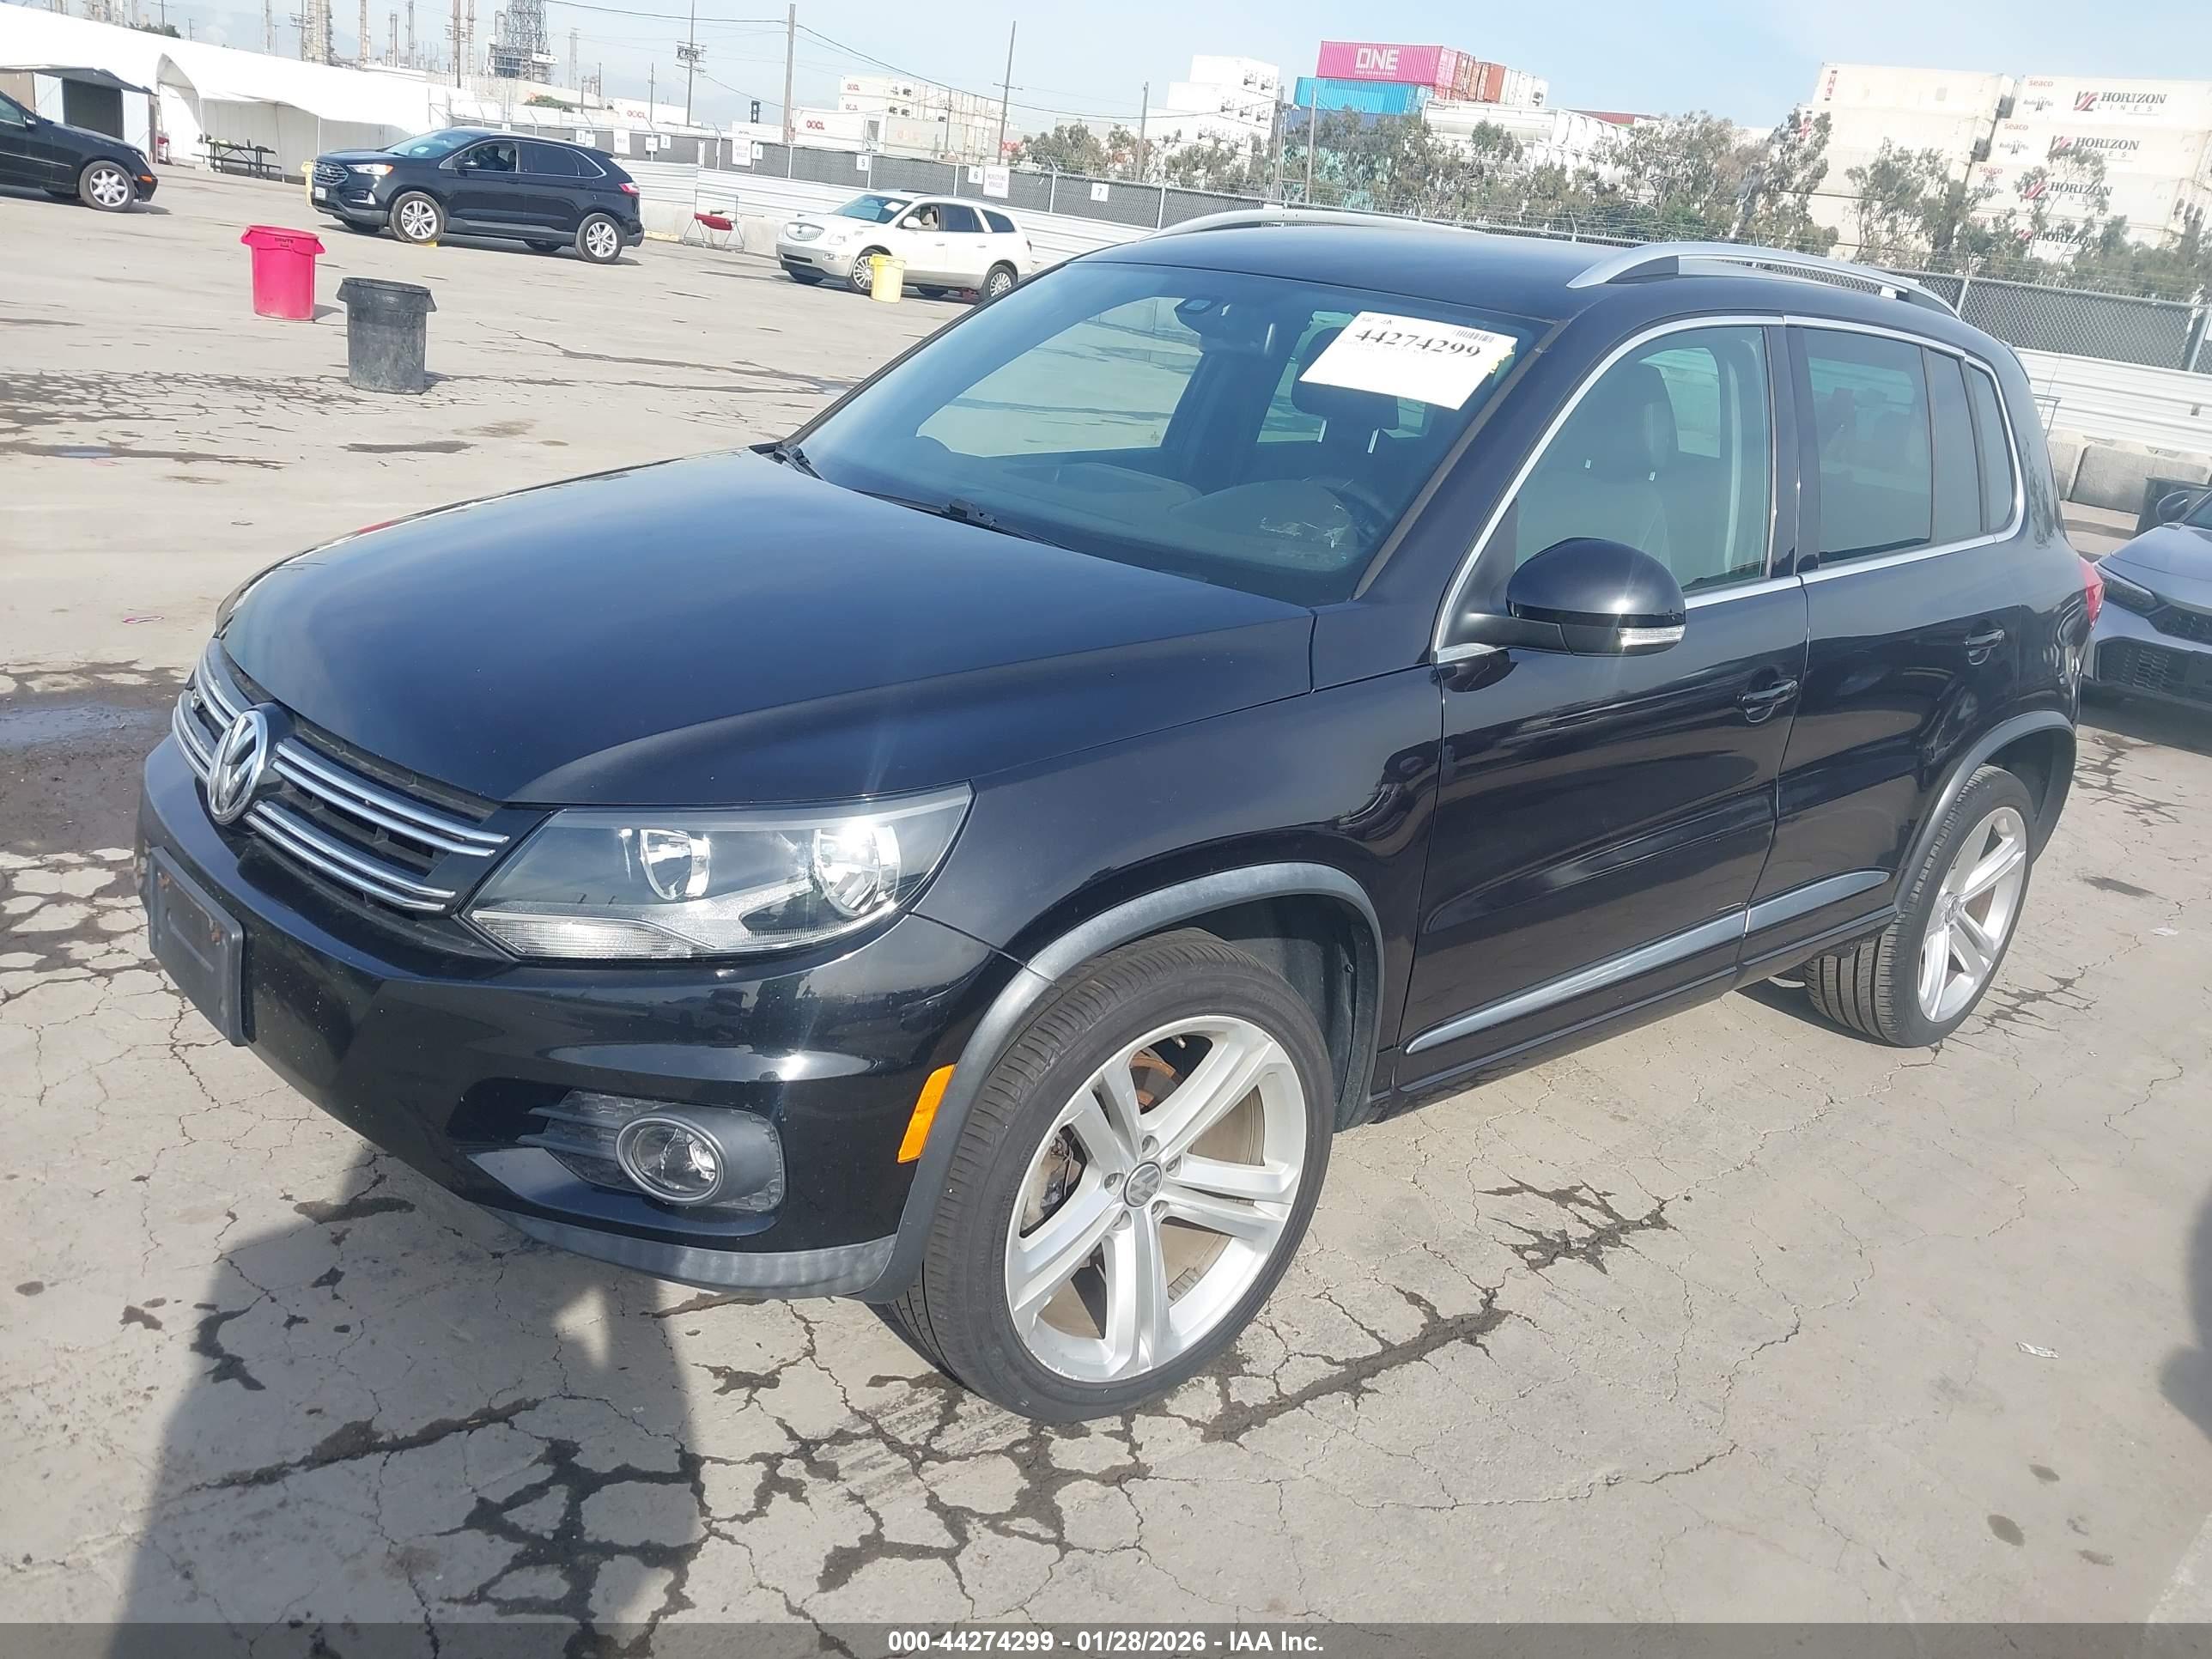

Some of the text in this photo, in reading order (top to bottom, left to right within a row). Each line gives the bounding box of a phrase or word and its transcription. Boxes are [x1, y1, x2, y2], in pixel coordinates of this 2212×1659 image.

[1356, 48, 1399, 70] ONE
[2028, 79, 2053, 88] seaco
[2100, 91, 2167, 104] HORIZON
[2097, 103, 2154, 112] LINES
[805, 119, 825, 131] OOCL
[2004, 123, 2029, 131] seaco
[2075, 137, 2141, 151] HORIZON
[1097, 187, 1103, 198] 7
[1354, 329, 1481, 357] 44274299
